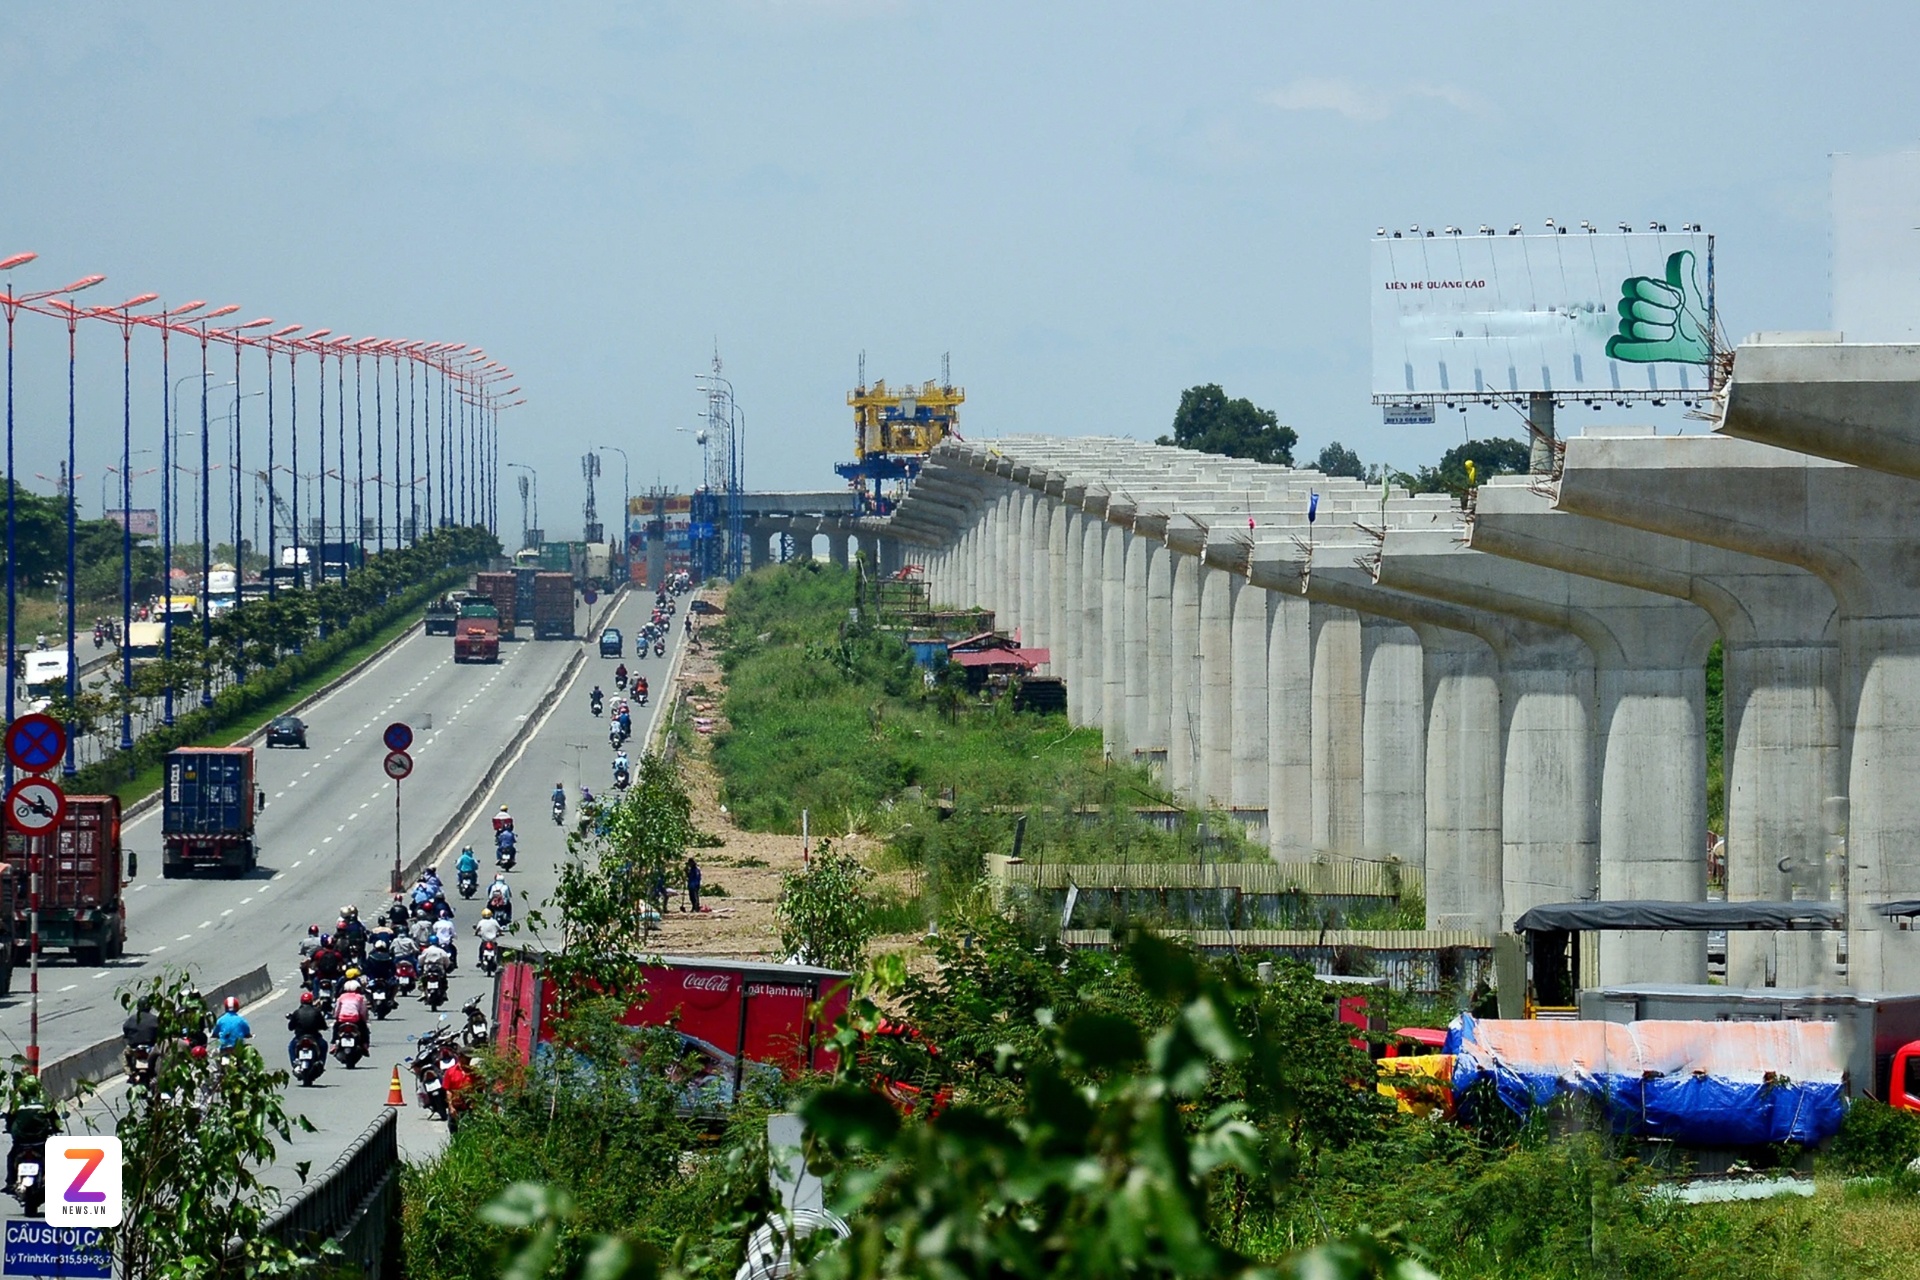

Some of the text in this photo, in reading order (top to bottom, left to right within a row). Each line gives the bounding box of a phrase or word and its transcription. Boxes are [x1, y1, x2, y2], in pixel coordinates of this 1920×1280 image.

[1385, 281, 1407, 290] LIÊN
[765, 985, 787, 997] lạnh
[7, 1223, 40, 1243] CẦU
[5, 1253, 16, 1265] Lý
